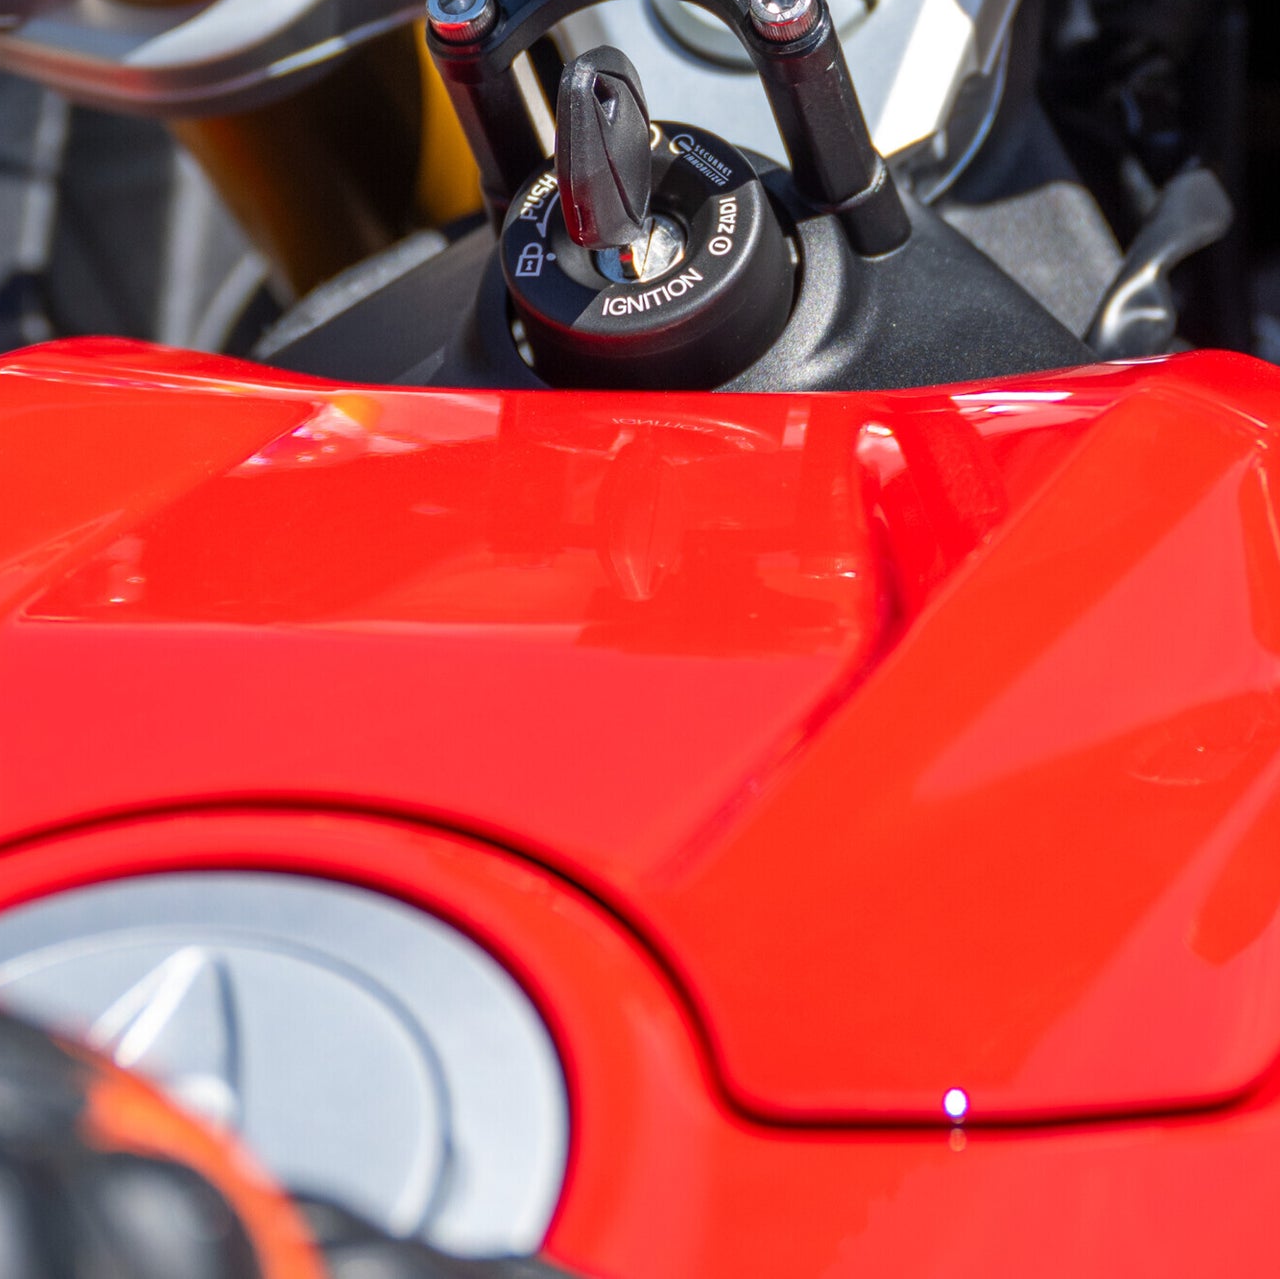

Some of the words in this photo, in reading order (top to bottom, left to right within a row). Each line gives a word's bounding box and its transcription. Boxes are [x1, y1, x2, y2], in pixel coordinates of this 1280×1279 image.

[683, 153, 727, 187] IMMOBILIZER
[519, 173, 559, 220] PUSH
[717, 196, 738, 235] ZADI
[601, 267, 704, 317] IGNITION
